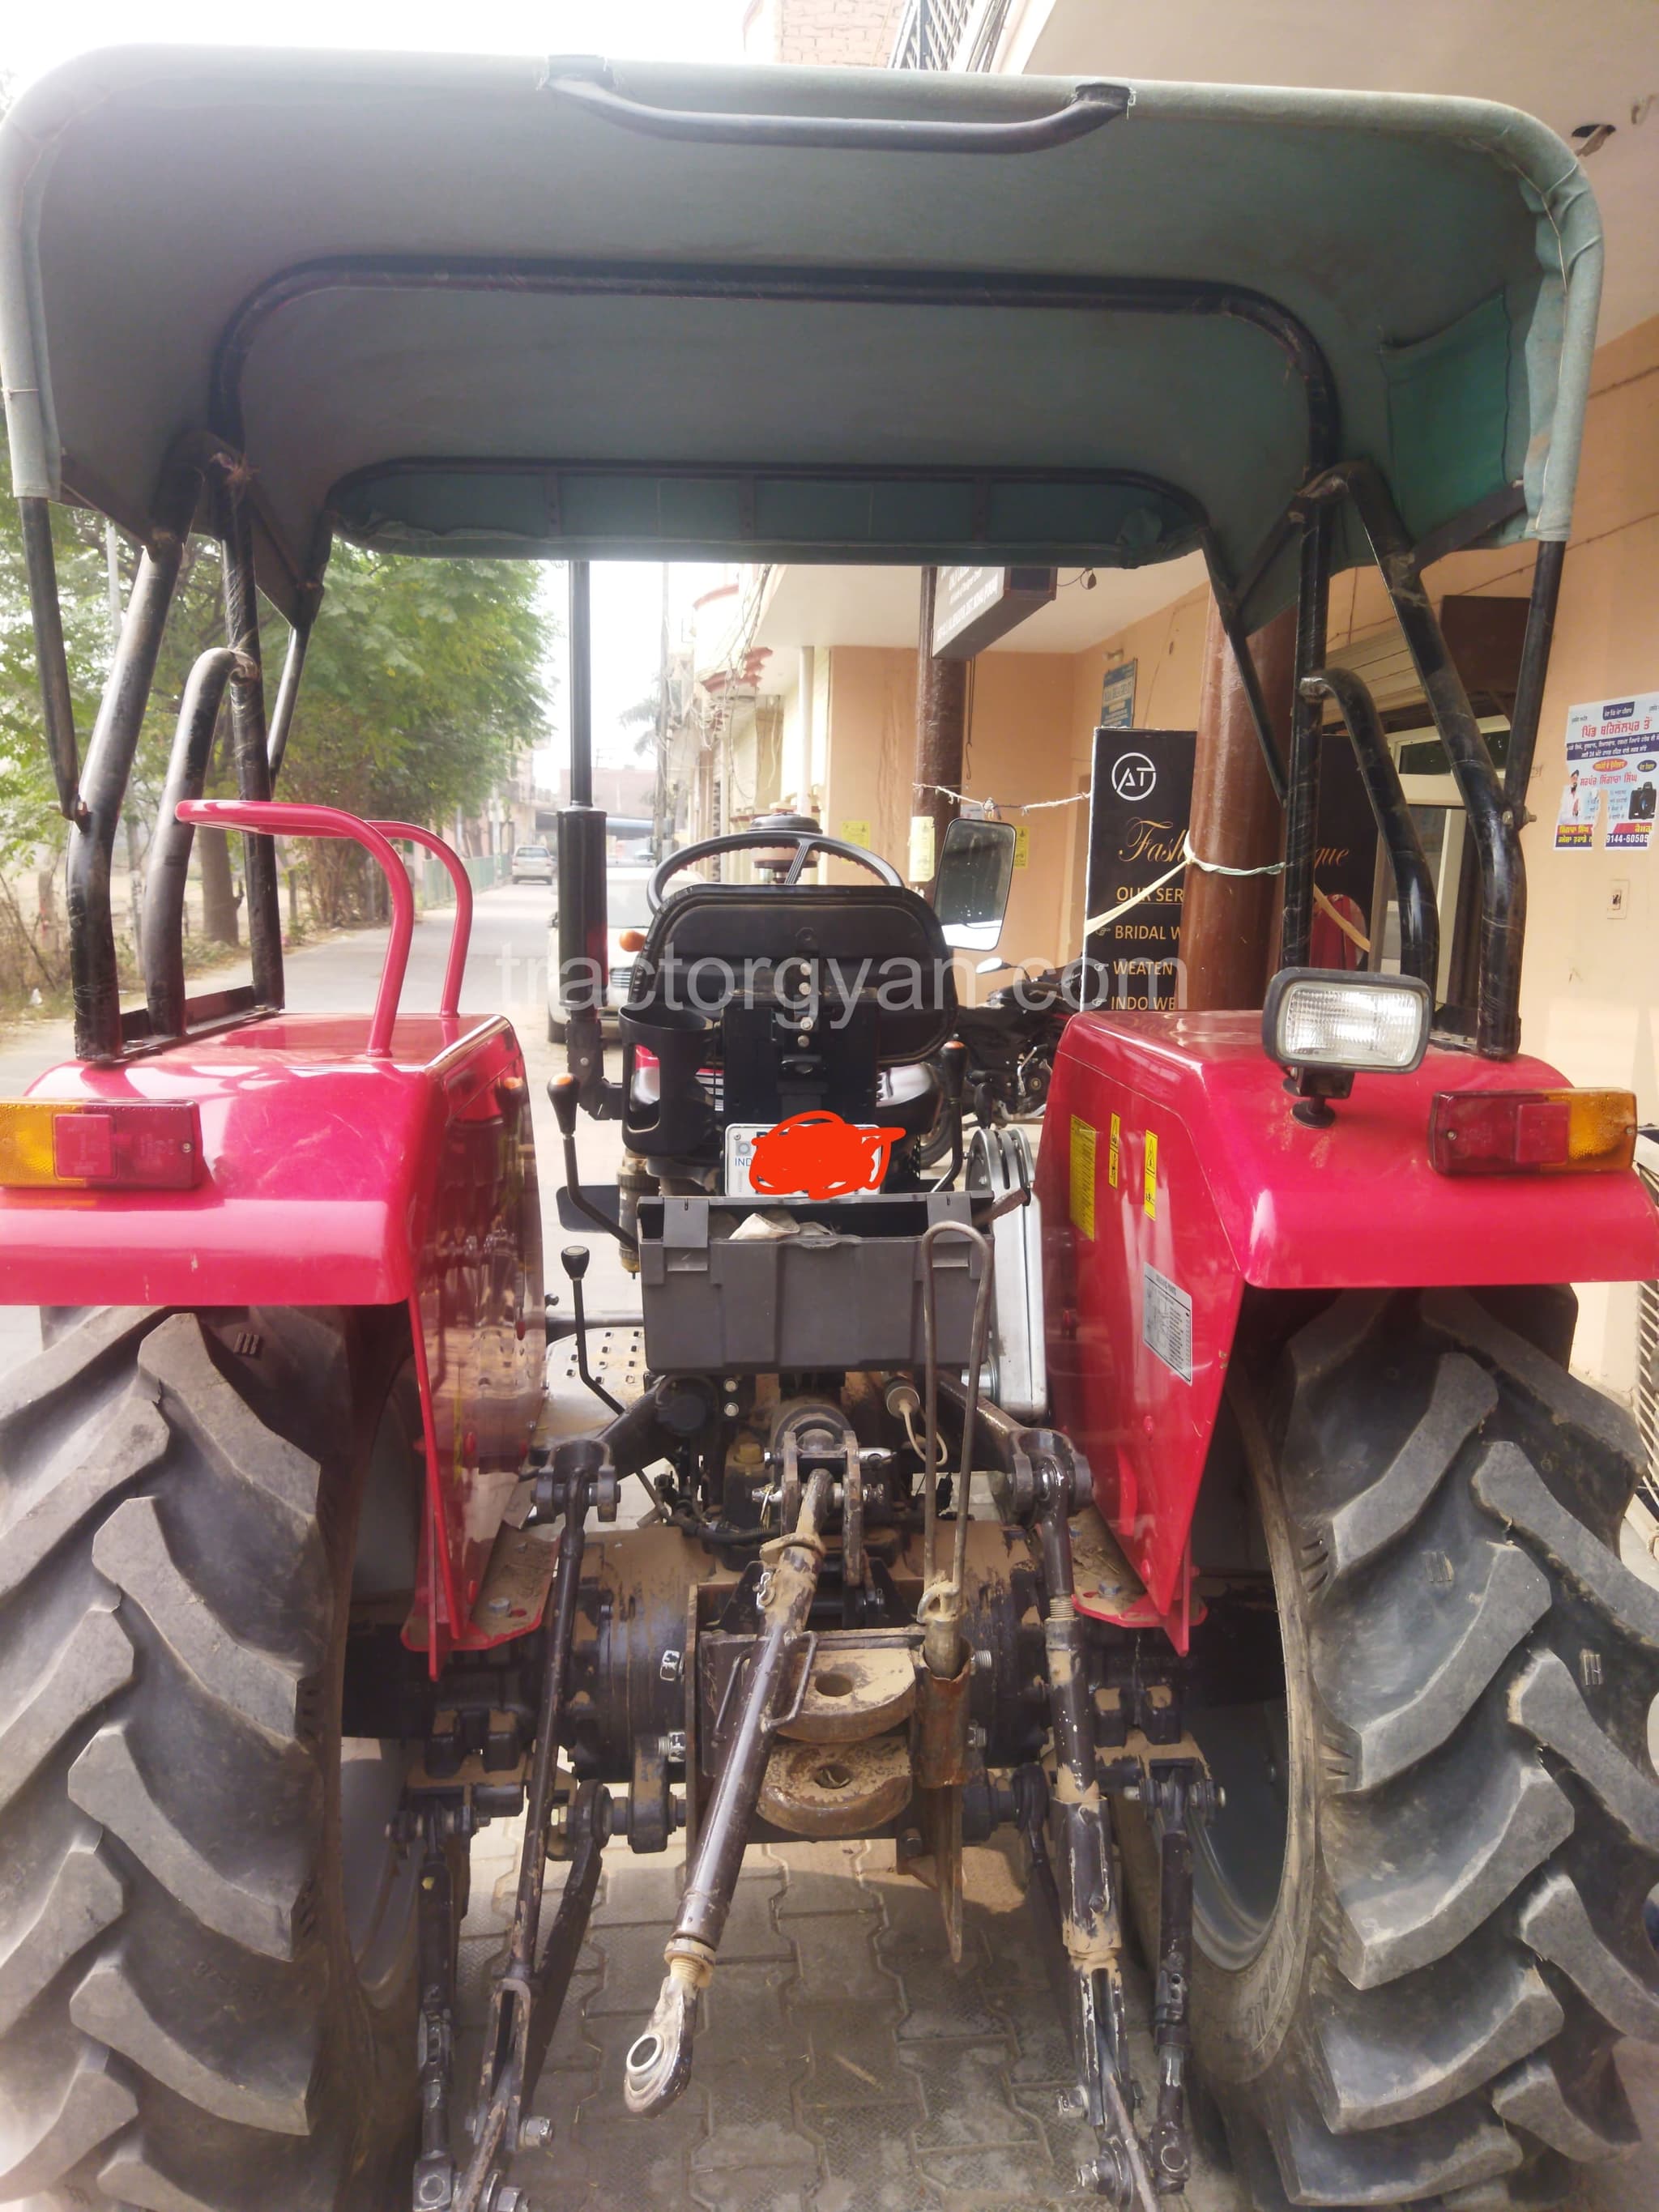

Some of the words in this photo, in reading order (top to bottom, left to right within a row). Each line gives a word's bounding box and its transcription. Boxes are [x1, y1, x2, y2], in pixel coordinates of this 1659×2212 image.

[1115, 925, 1166, 940] BRIDAL
[1113, 961, 1173, 975] WEATEN
[1111, 996, 1149, 1011] INDO
[735, 1157, 752, 1167] IND
